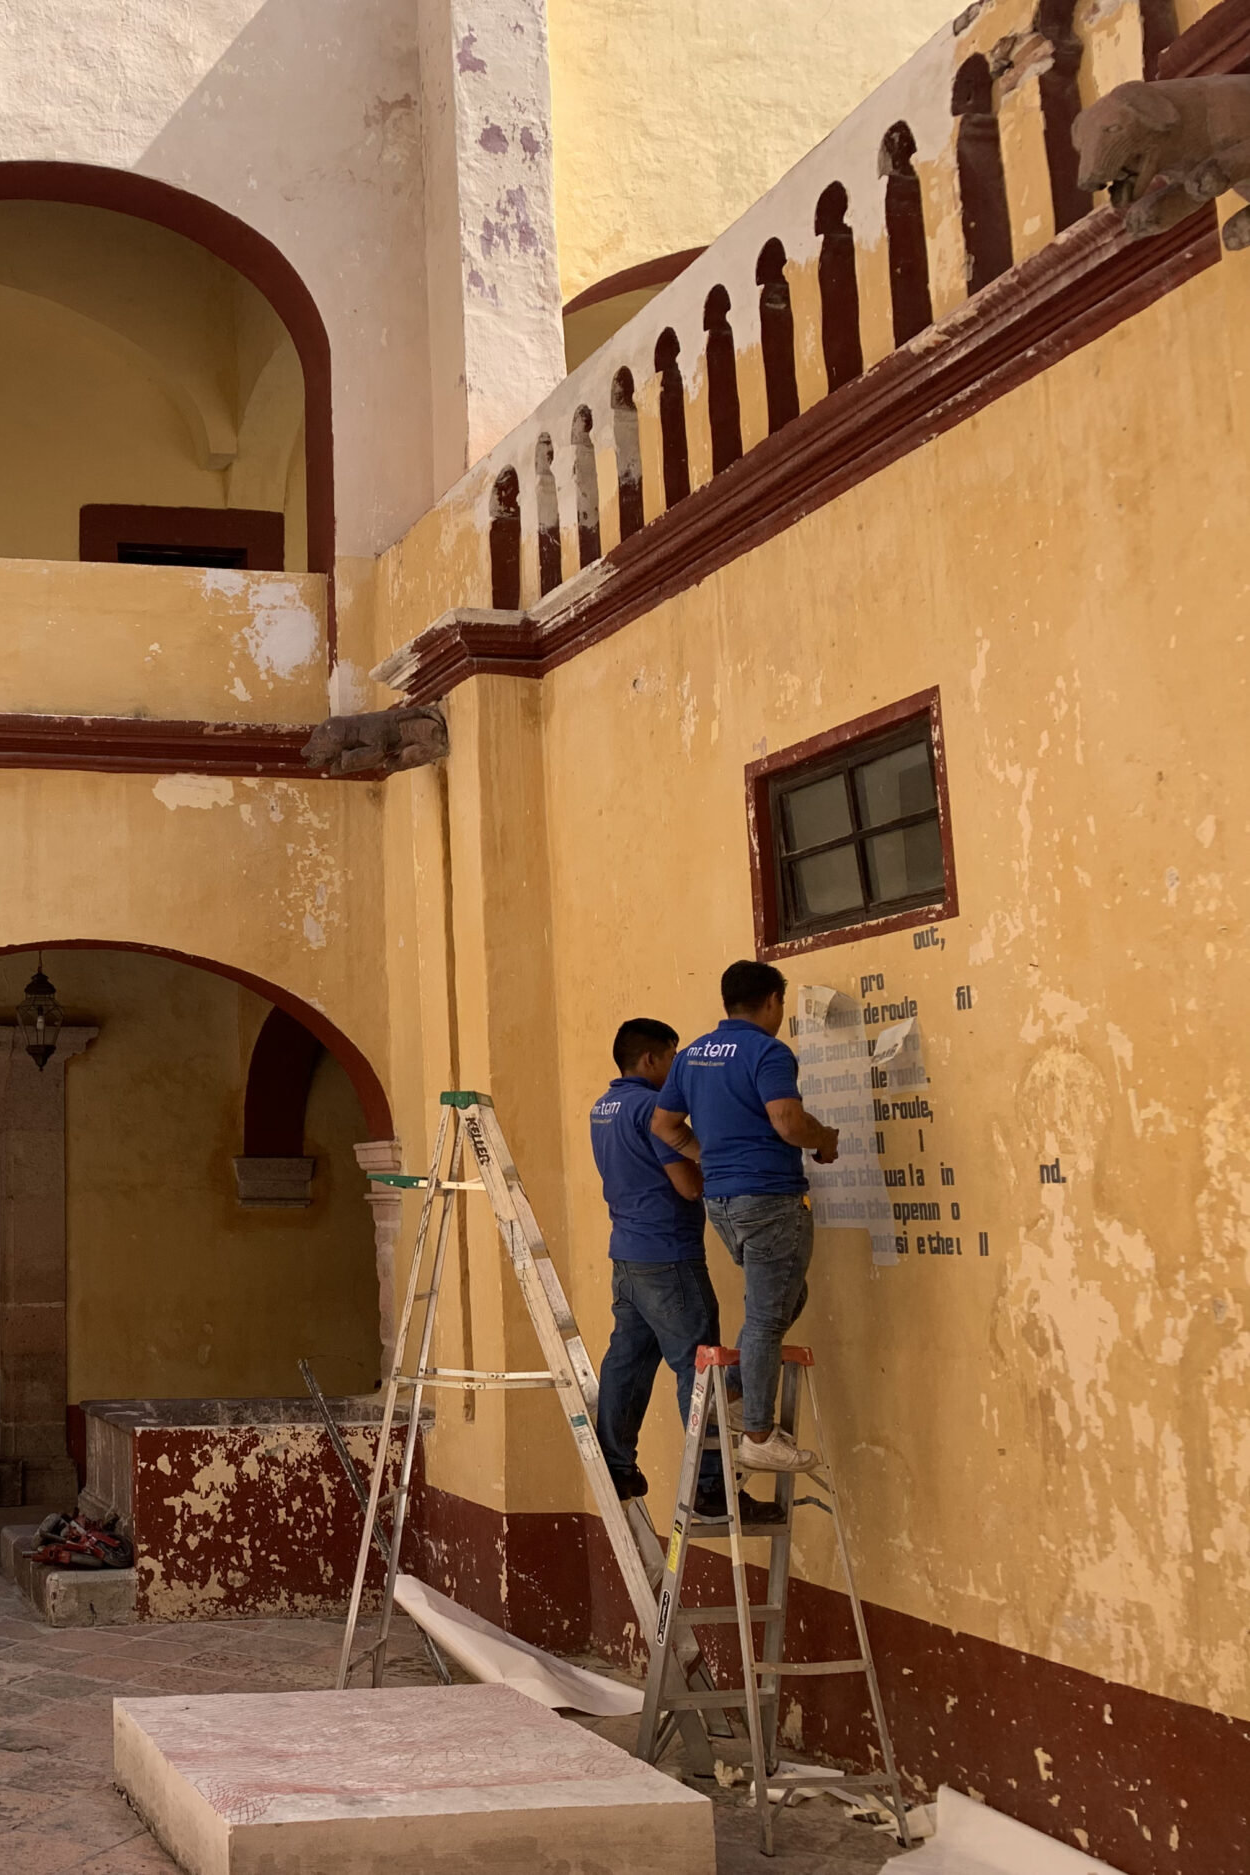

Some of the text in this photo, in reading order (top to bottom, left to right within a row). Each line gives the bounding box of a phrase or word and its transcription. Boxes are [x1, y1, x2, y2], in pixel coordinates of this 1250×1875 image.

[913, 926, 946, 951] out,
[860, 973, 885, 998] pro
[863, 1002, 880, 1025] de
[881, 996, 918, 1023] roule
[892, 1096, 934, 1123] roule,
[465, 1116, 491, 1167] KELLER
[1040, 1158, 1067, 1184] nd.
